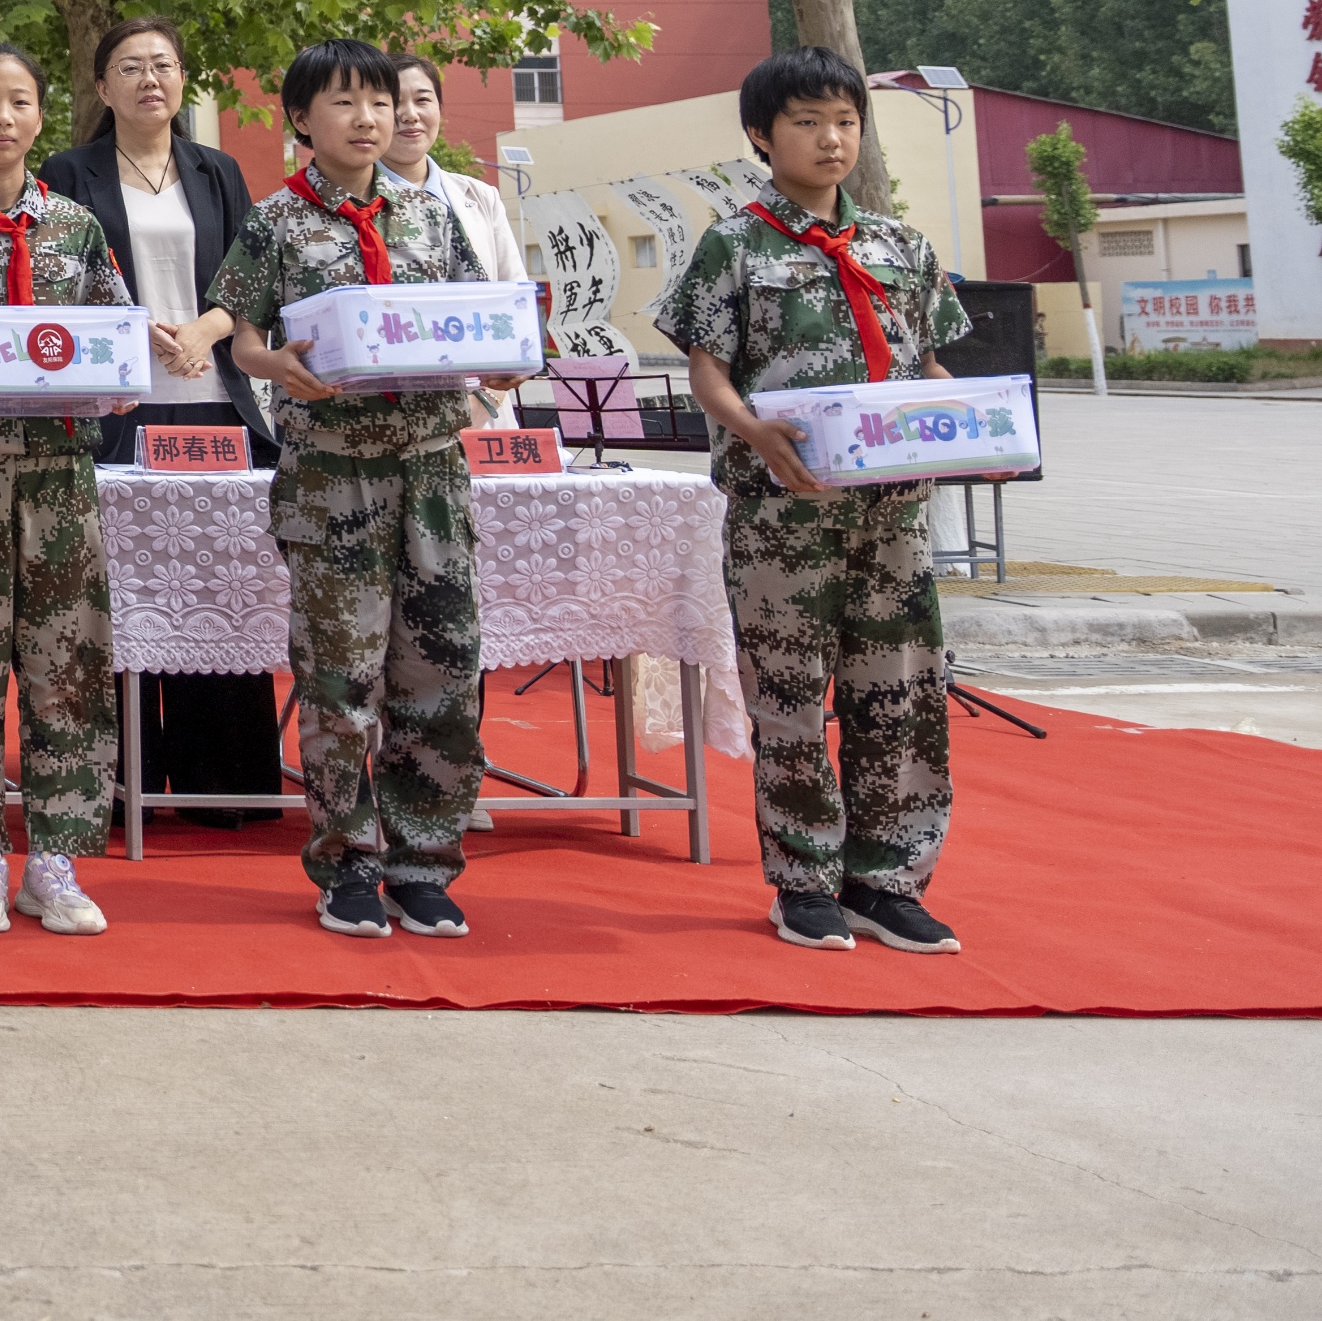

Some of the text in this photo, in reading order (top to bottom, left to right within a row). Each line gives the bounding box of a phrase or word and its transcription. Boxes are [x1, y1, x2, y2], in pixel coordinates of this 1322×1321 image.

[1136, 295, 1199, 316] 文明校园
[41, 346, 62, 356] AIA
[153, 435, 238, 463] 郝春艳
[478, 436, 542, 464] 卫魏
